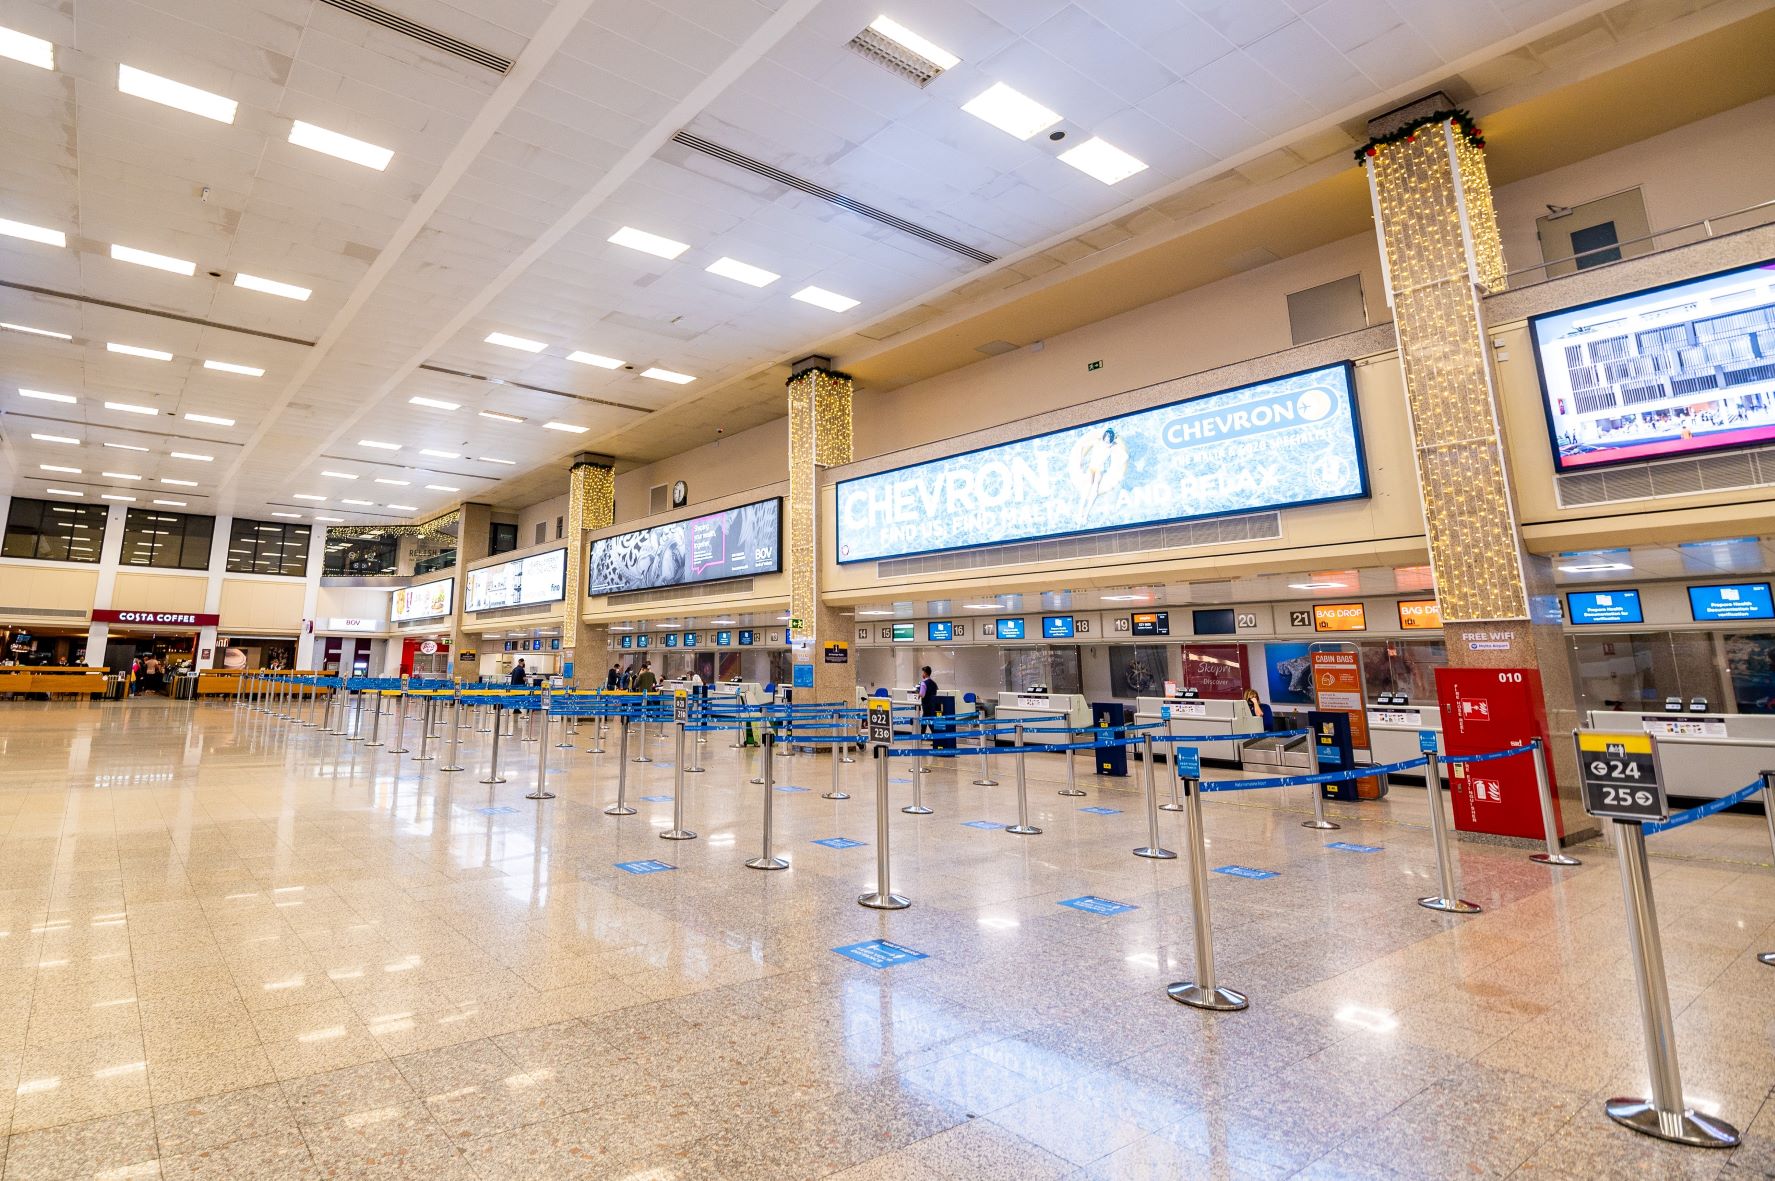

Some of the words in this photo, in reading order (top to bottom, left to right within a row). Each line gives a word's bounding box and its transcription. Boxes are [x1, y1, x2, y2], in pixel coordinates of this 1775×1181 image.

[1167, 400, 1295, 444] CHEVRON
[843, 450, 1051, 529] CHEVRON
[879, 526, 917, 546] FIND
[952, 511, 995, 533] FIND
[1180, 463, 1280, 499] RELAX
[755, 546, 773, 560] BOV
[1316, 609, 1335, 618] BAG
[1337, 608, 1362, 617] DROP
[1401, 606, 1423, 615] BAG
[1425, 606, 1440, 614] DR
[119, 612, 154, 622] COSTA
[156, 613, 195, 623] COFFEE
[1238, 614, 1256, 627] 20
[1293, 612, 1309, 626] 21
[954, 625, 963, 636] 16
[984, 625, 993, 635] 17
[1076, 621, 1088, 632] 18
[1115, 620, 1128, 631] 19
[859, 629, 867, 639] 14
[882, 628, 891, 639] 15
[1462, 632, 1487, 641] FREE
[1489, 631, 1515, 640] WIFI
[1315, 655, 1335, 663] CABIN
[1197, 662, 1231, 676] Skopri
[1498, 672, 1522, 683] 010
[877, 714, 886, 724] 22
[874, 728, 883, 738] 23
[1609, 760, 1641, 779] 24
[1602, 787, 1633, 806] 25
